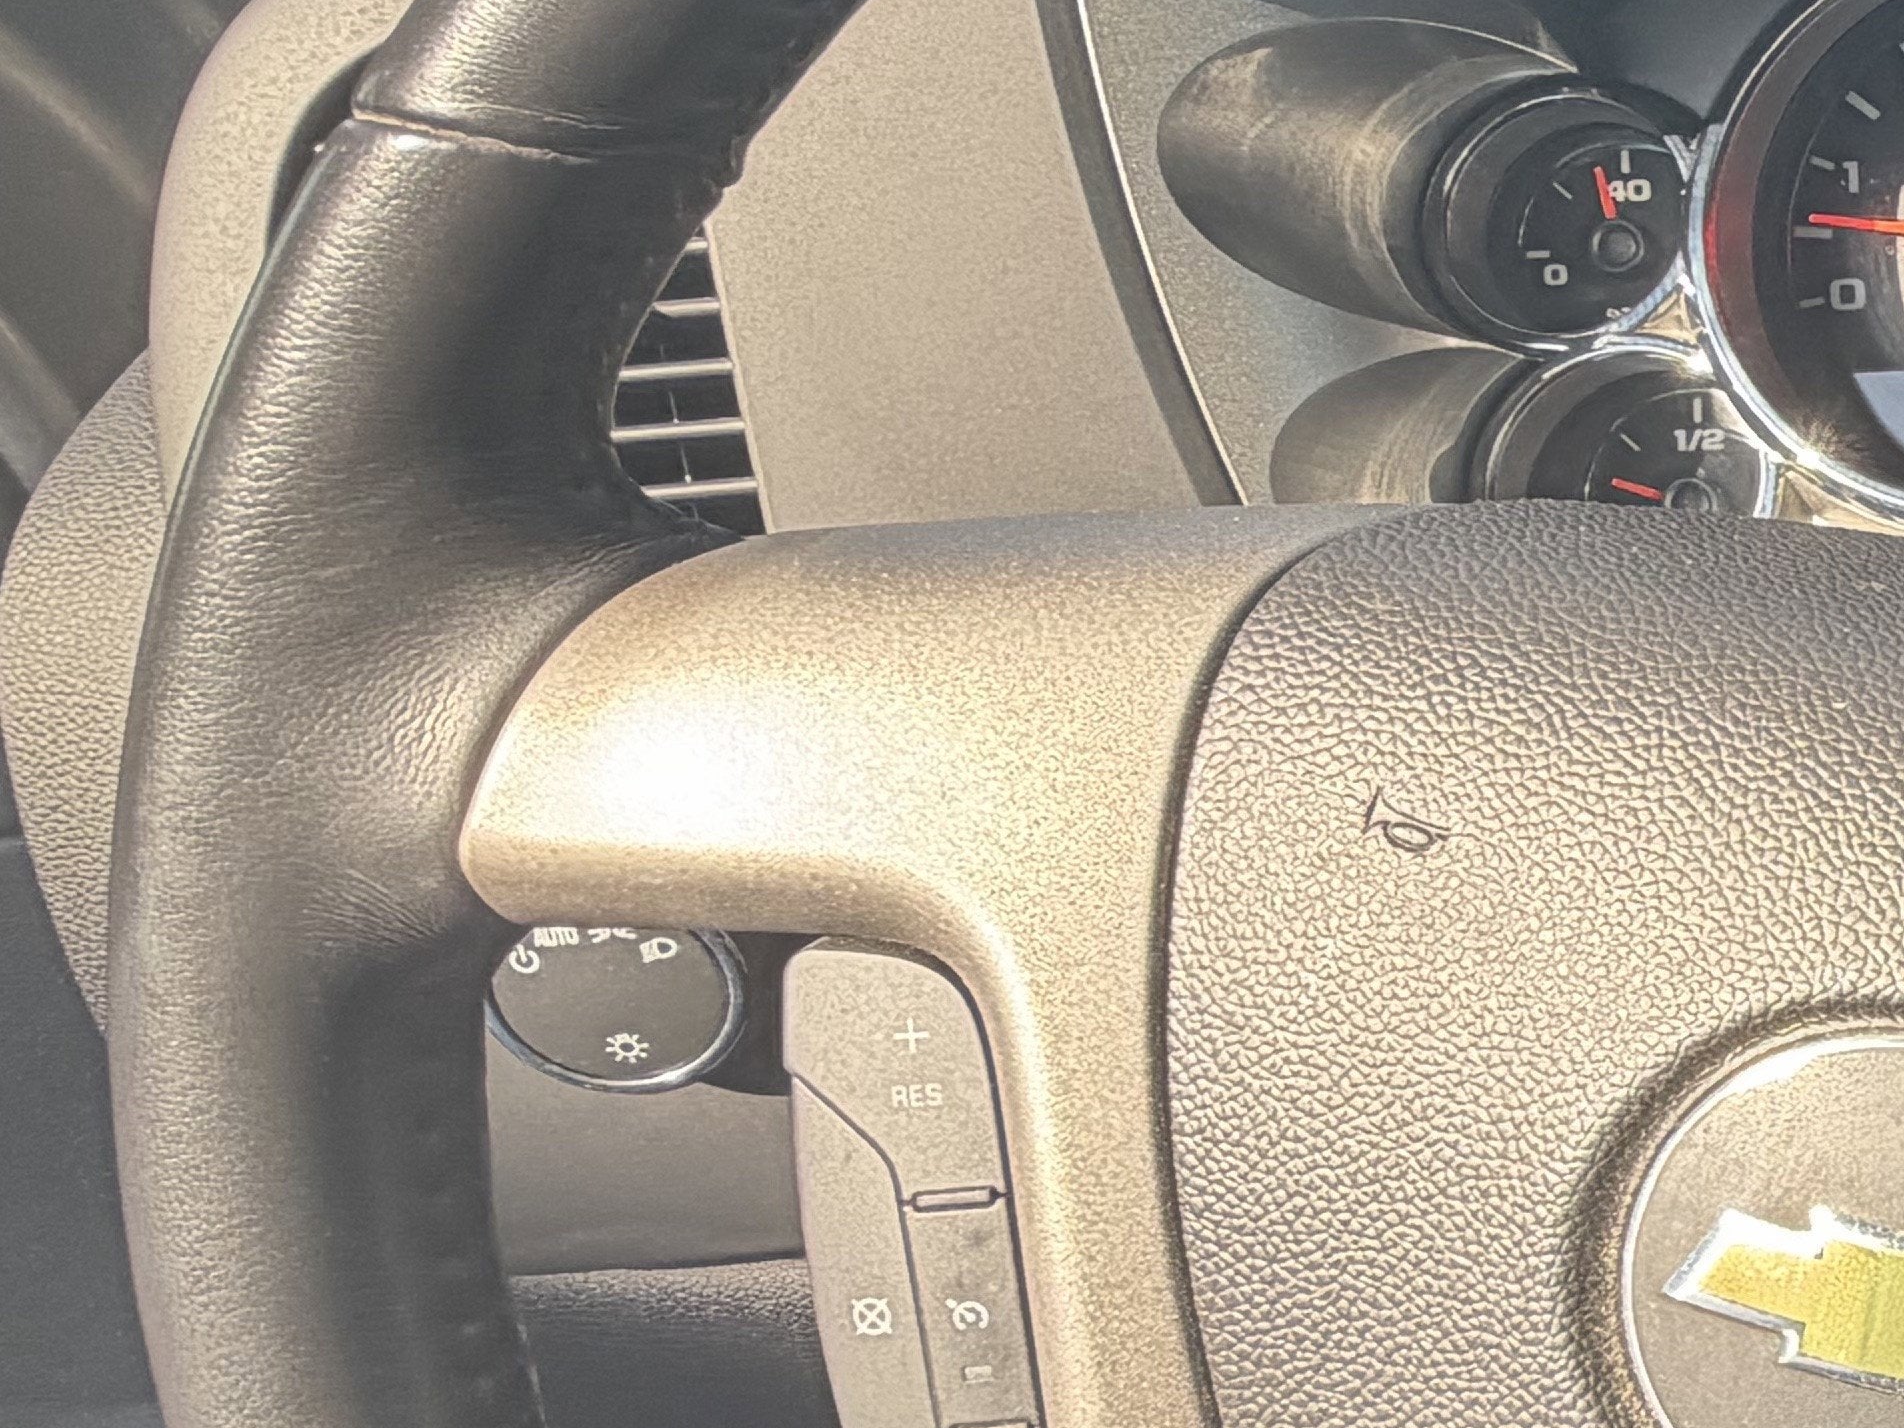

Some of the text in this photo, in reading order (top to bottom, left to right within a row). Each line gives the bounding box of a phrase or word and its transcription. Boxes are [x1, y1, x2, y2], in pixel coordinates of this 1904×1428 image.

[1607, 178, 1652, 202] 40
[1841, 162, 1860, 194] 1
[1543, 264, 1568, 286] 0
[1829, 278, 1867, 311] 0
[1673, 428, 1725, 452] 1/2
[533, 926, 580, 948] AUTO
[889, 1082, 944, 1110] RES
